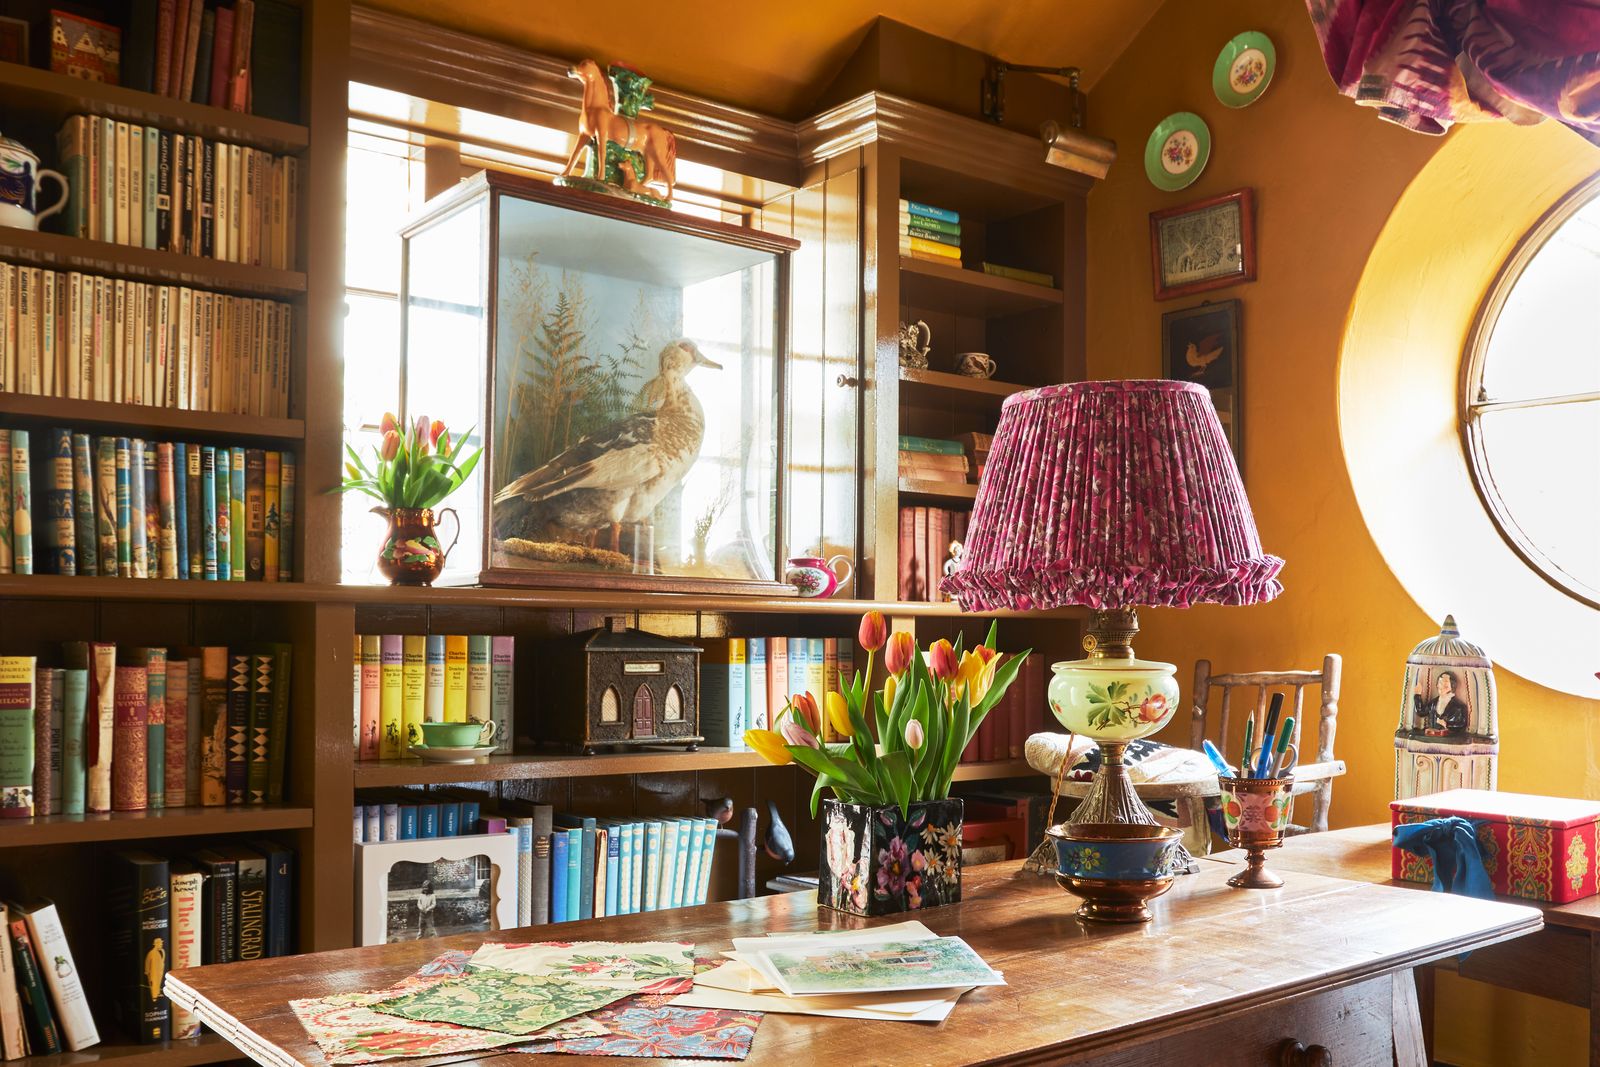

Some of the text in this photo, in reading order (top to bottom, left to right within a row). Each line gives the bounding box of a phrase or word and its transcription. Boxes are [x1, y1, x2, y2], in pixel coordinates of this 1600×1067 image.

[160, 163, 169, 192] CHRISTIE
[52, 728, 61, 772] PONY HUNT
[178, 892, 194, 927] The
[241, 890, 264, 959] STALINGRAD
